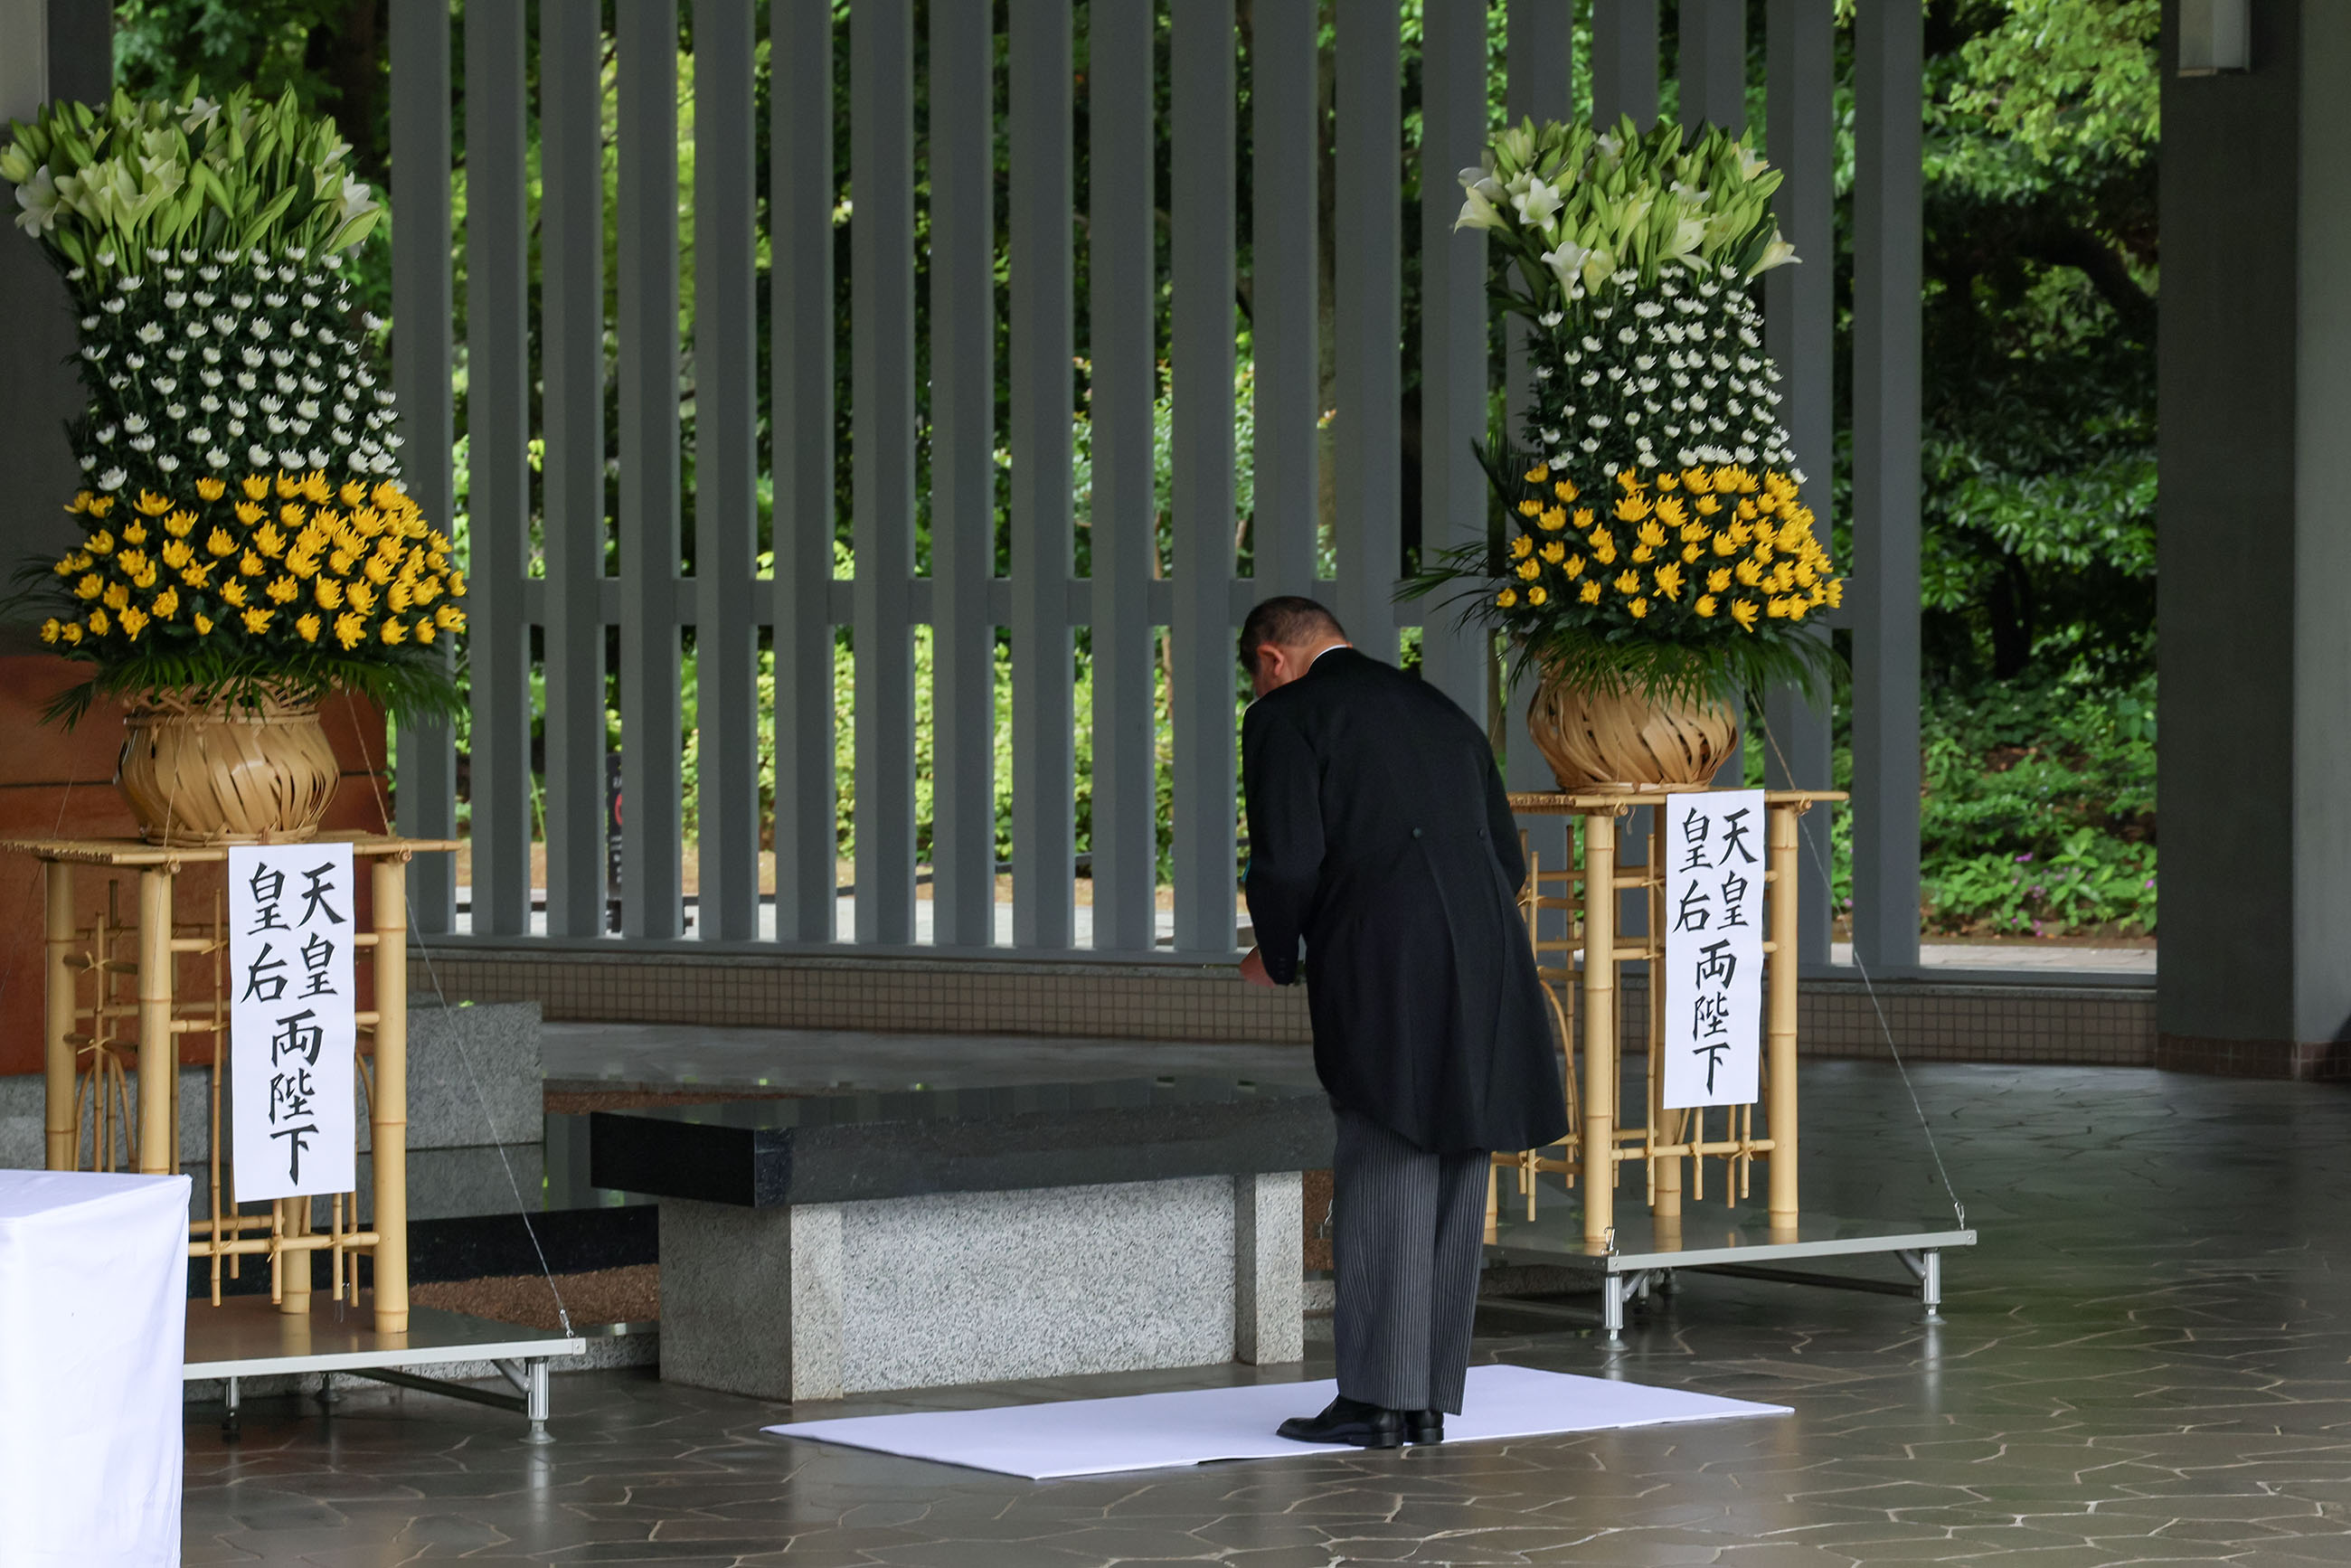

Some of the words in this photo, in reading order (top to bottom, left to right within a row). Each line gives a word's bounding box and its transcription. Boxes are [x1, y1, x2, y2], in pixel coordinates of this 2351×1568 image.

[240, 861, 292, 1004] 皇后
[297, 861, 347, 999] 天皇
[1672, 807, 1714, 933] 皇后
[1717, 808, 1759, 930] 天皇
[1692, 939, 1738, 1097] 両陛下
[269, 1008, 325, 1186] 両陛下
